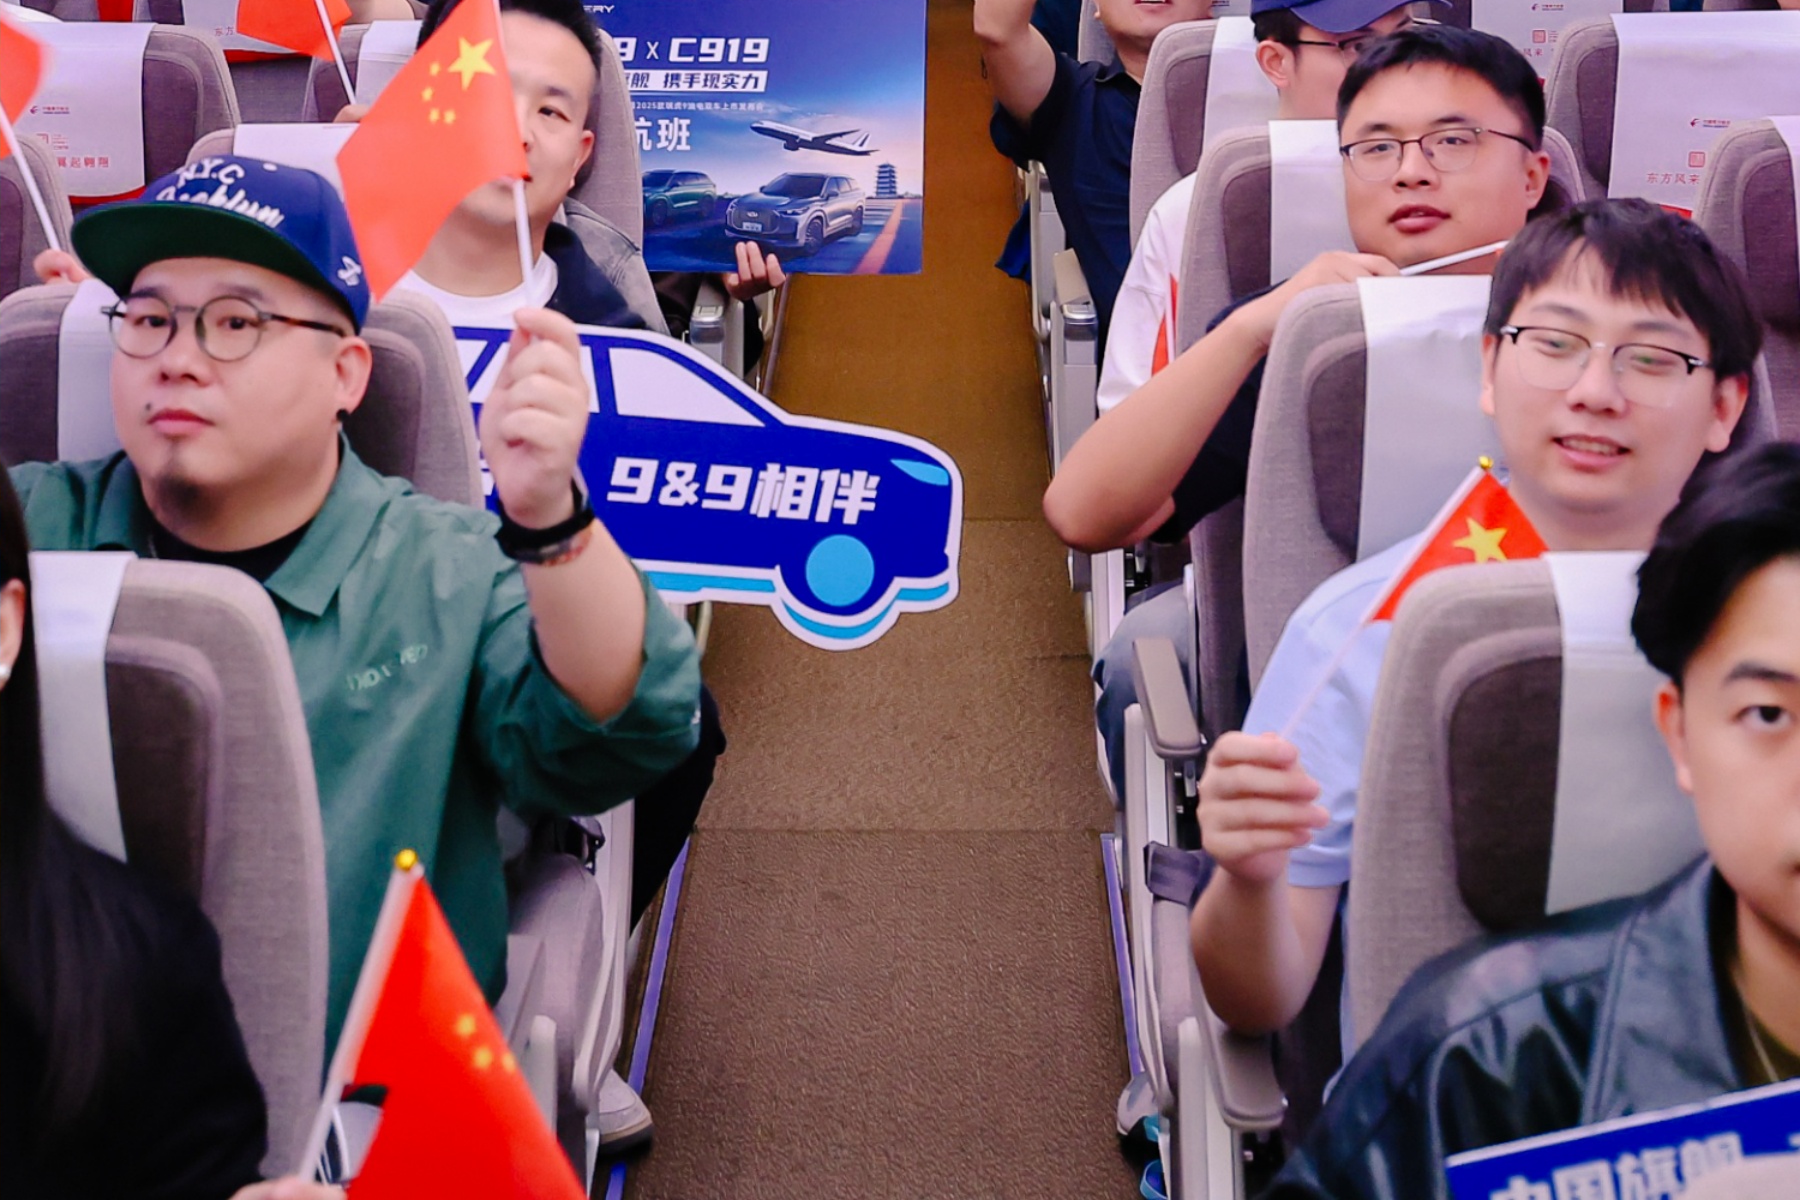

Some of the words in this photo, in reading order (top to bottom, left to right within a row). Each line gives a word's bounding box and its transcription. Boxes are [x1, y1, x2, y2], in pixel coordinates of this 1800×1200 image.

[669, 37, 770, 63] C919
[663, 71, 760, 90] 携手现实力
[607, 457, 881, 525] 9&9相伴
